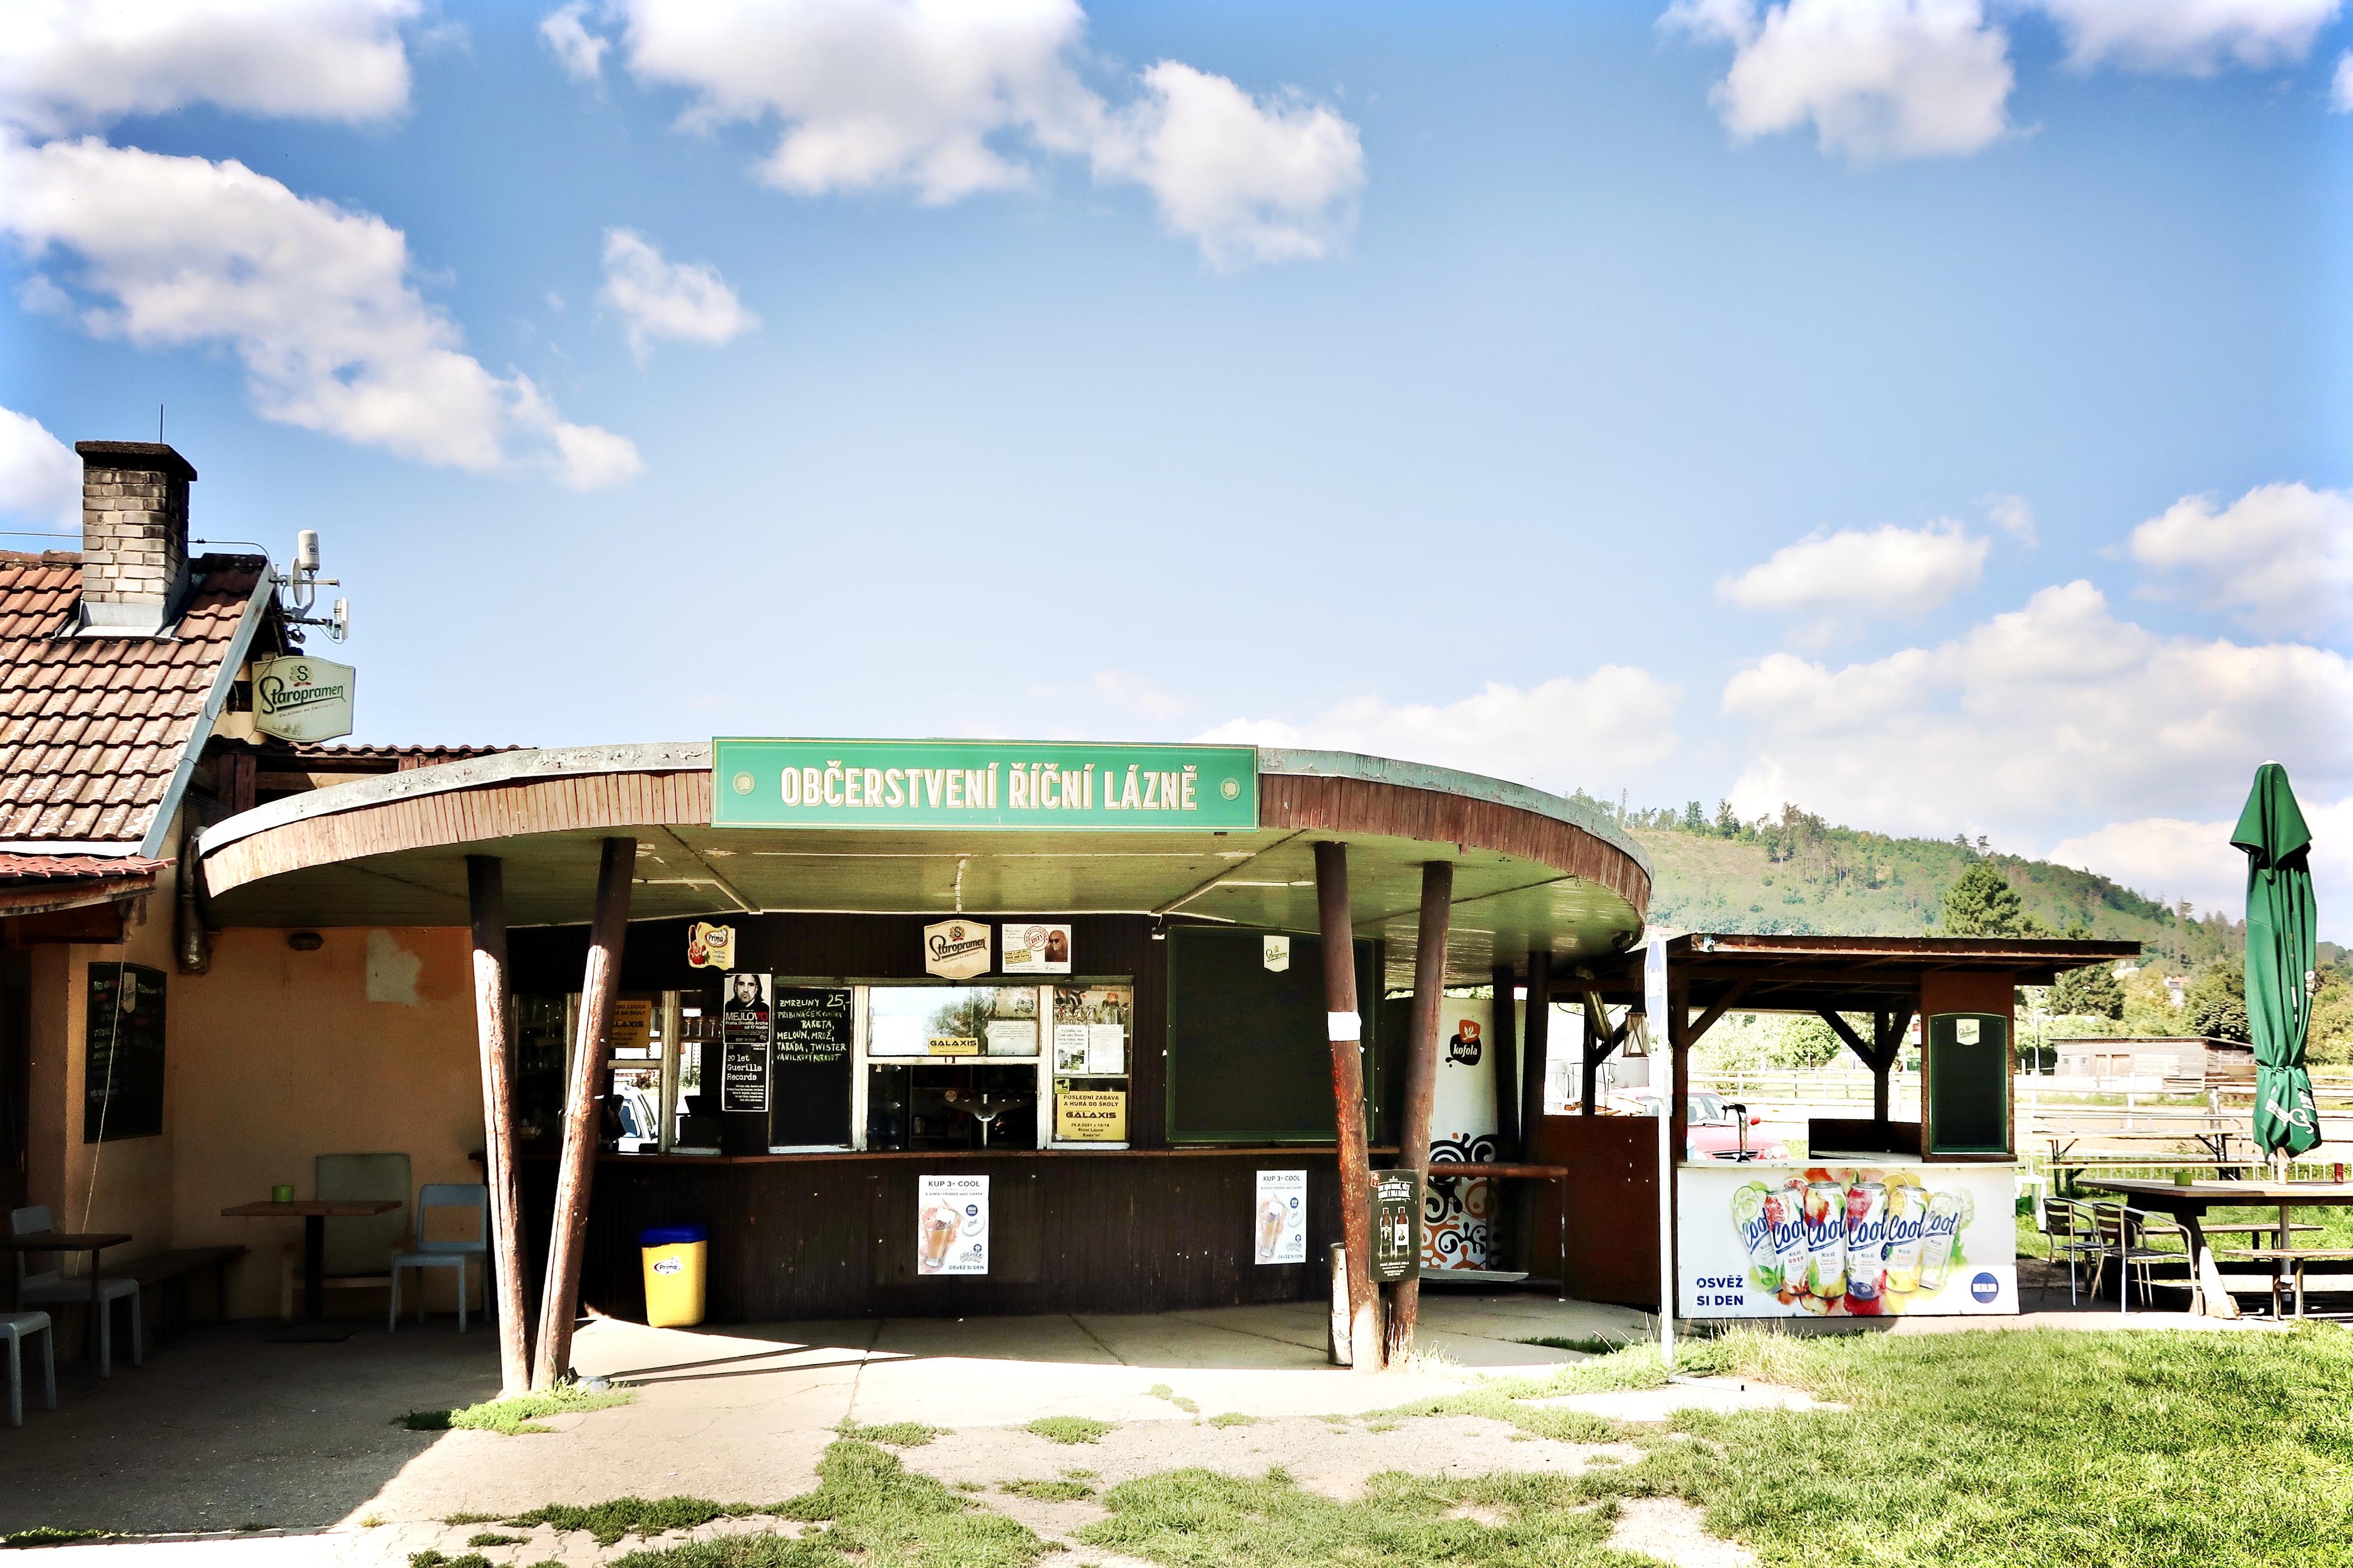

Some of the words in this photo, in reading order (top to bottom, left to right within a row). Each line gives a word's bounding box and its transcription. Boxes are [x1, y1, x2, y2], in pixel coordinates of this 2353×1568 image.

[259, 676, 346, 715] Staropramen
[781, 759, 1000, 809] OBČERSTVENÍ
[1008, 762, 1095, 810] ŘÍČNÍ
[1104, 763, 1198, 810] LÁZNĚ
[708, 933, 724, 942] Prima
[1030, 934, 1043, 944] 2021
[929, 935, 987, 962] Staropramen
[779, 999, 819, 1007] ZMRZLINY
[801, 1020, 834, 1030] RAKETA,
[777, 1030, 810, 1040] MELOUN,
[776, 1040, 808, 1053] PARÁDA,
[810, 1043, 846, 1051] TWISTER
[1453, 1044, 1478, 1057] kofola
[727, 1063, 762, 1072] Guerilla
[1697, 1275, 1743, 1289] OSVĚŽ
[1697, 1295, 1709, 1306] SI
[1715, 1295, 1743, 1306] DEN
